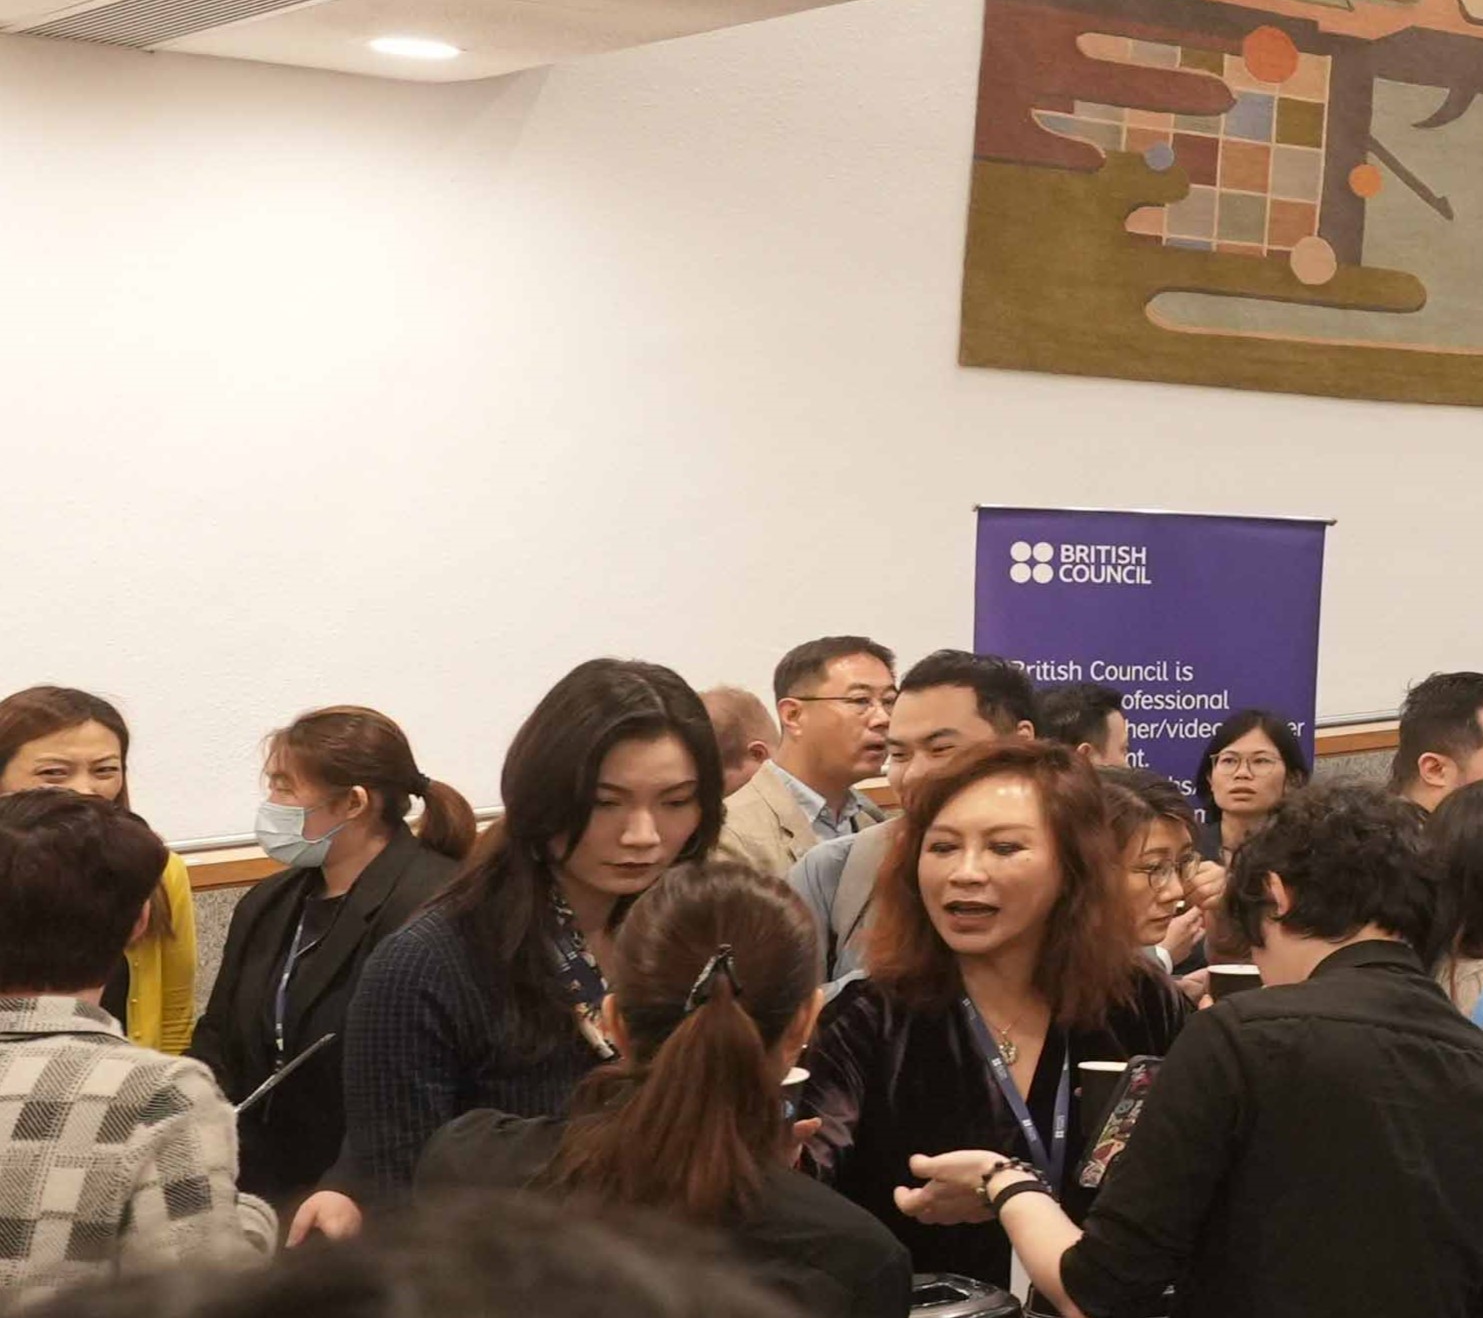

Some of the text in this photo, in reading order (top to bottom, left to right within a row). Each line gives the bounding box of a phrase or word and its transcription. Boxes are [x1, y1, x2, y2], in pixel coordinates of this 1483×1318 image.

[1060, 544, 1147, 565] BRITISH
[1058, 564, 1152, 585] COUNCIL
[1089, 659, 1169, 682] Council
[1174, 660, 1195, 681] is
